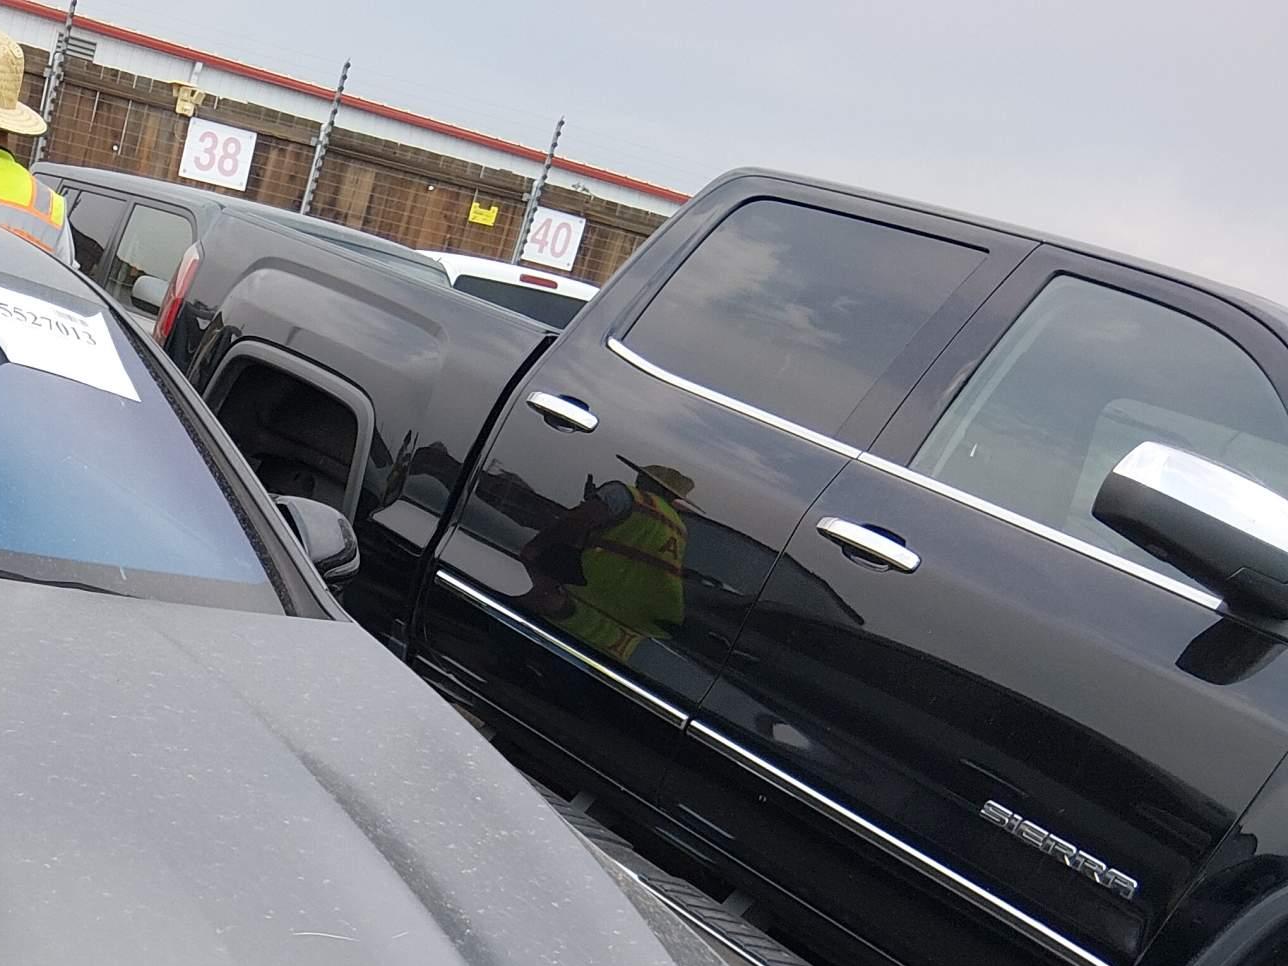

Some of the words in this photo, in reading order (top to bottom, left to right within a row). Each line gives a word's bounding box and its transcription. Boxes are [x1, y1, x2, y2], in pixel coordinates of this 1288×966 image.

[193, 131, 242, 178] 38
[528, 217, 573, 259] 40
[978, 799, 1138, 900] SIERRA
